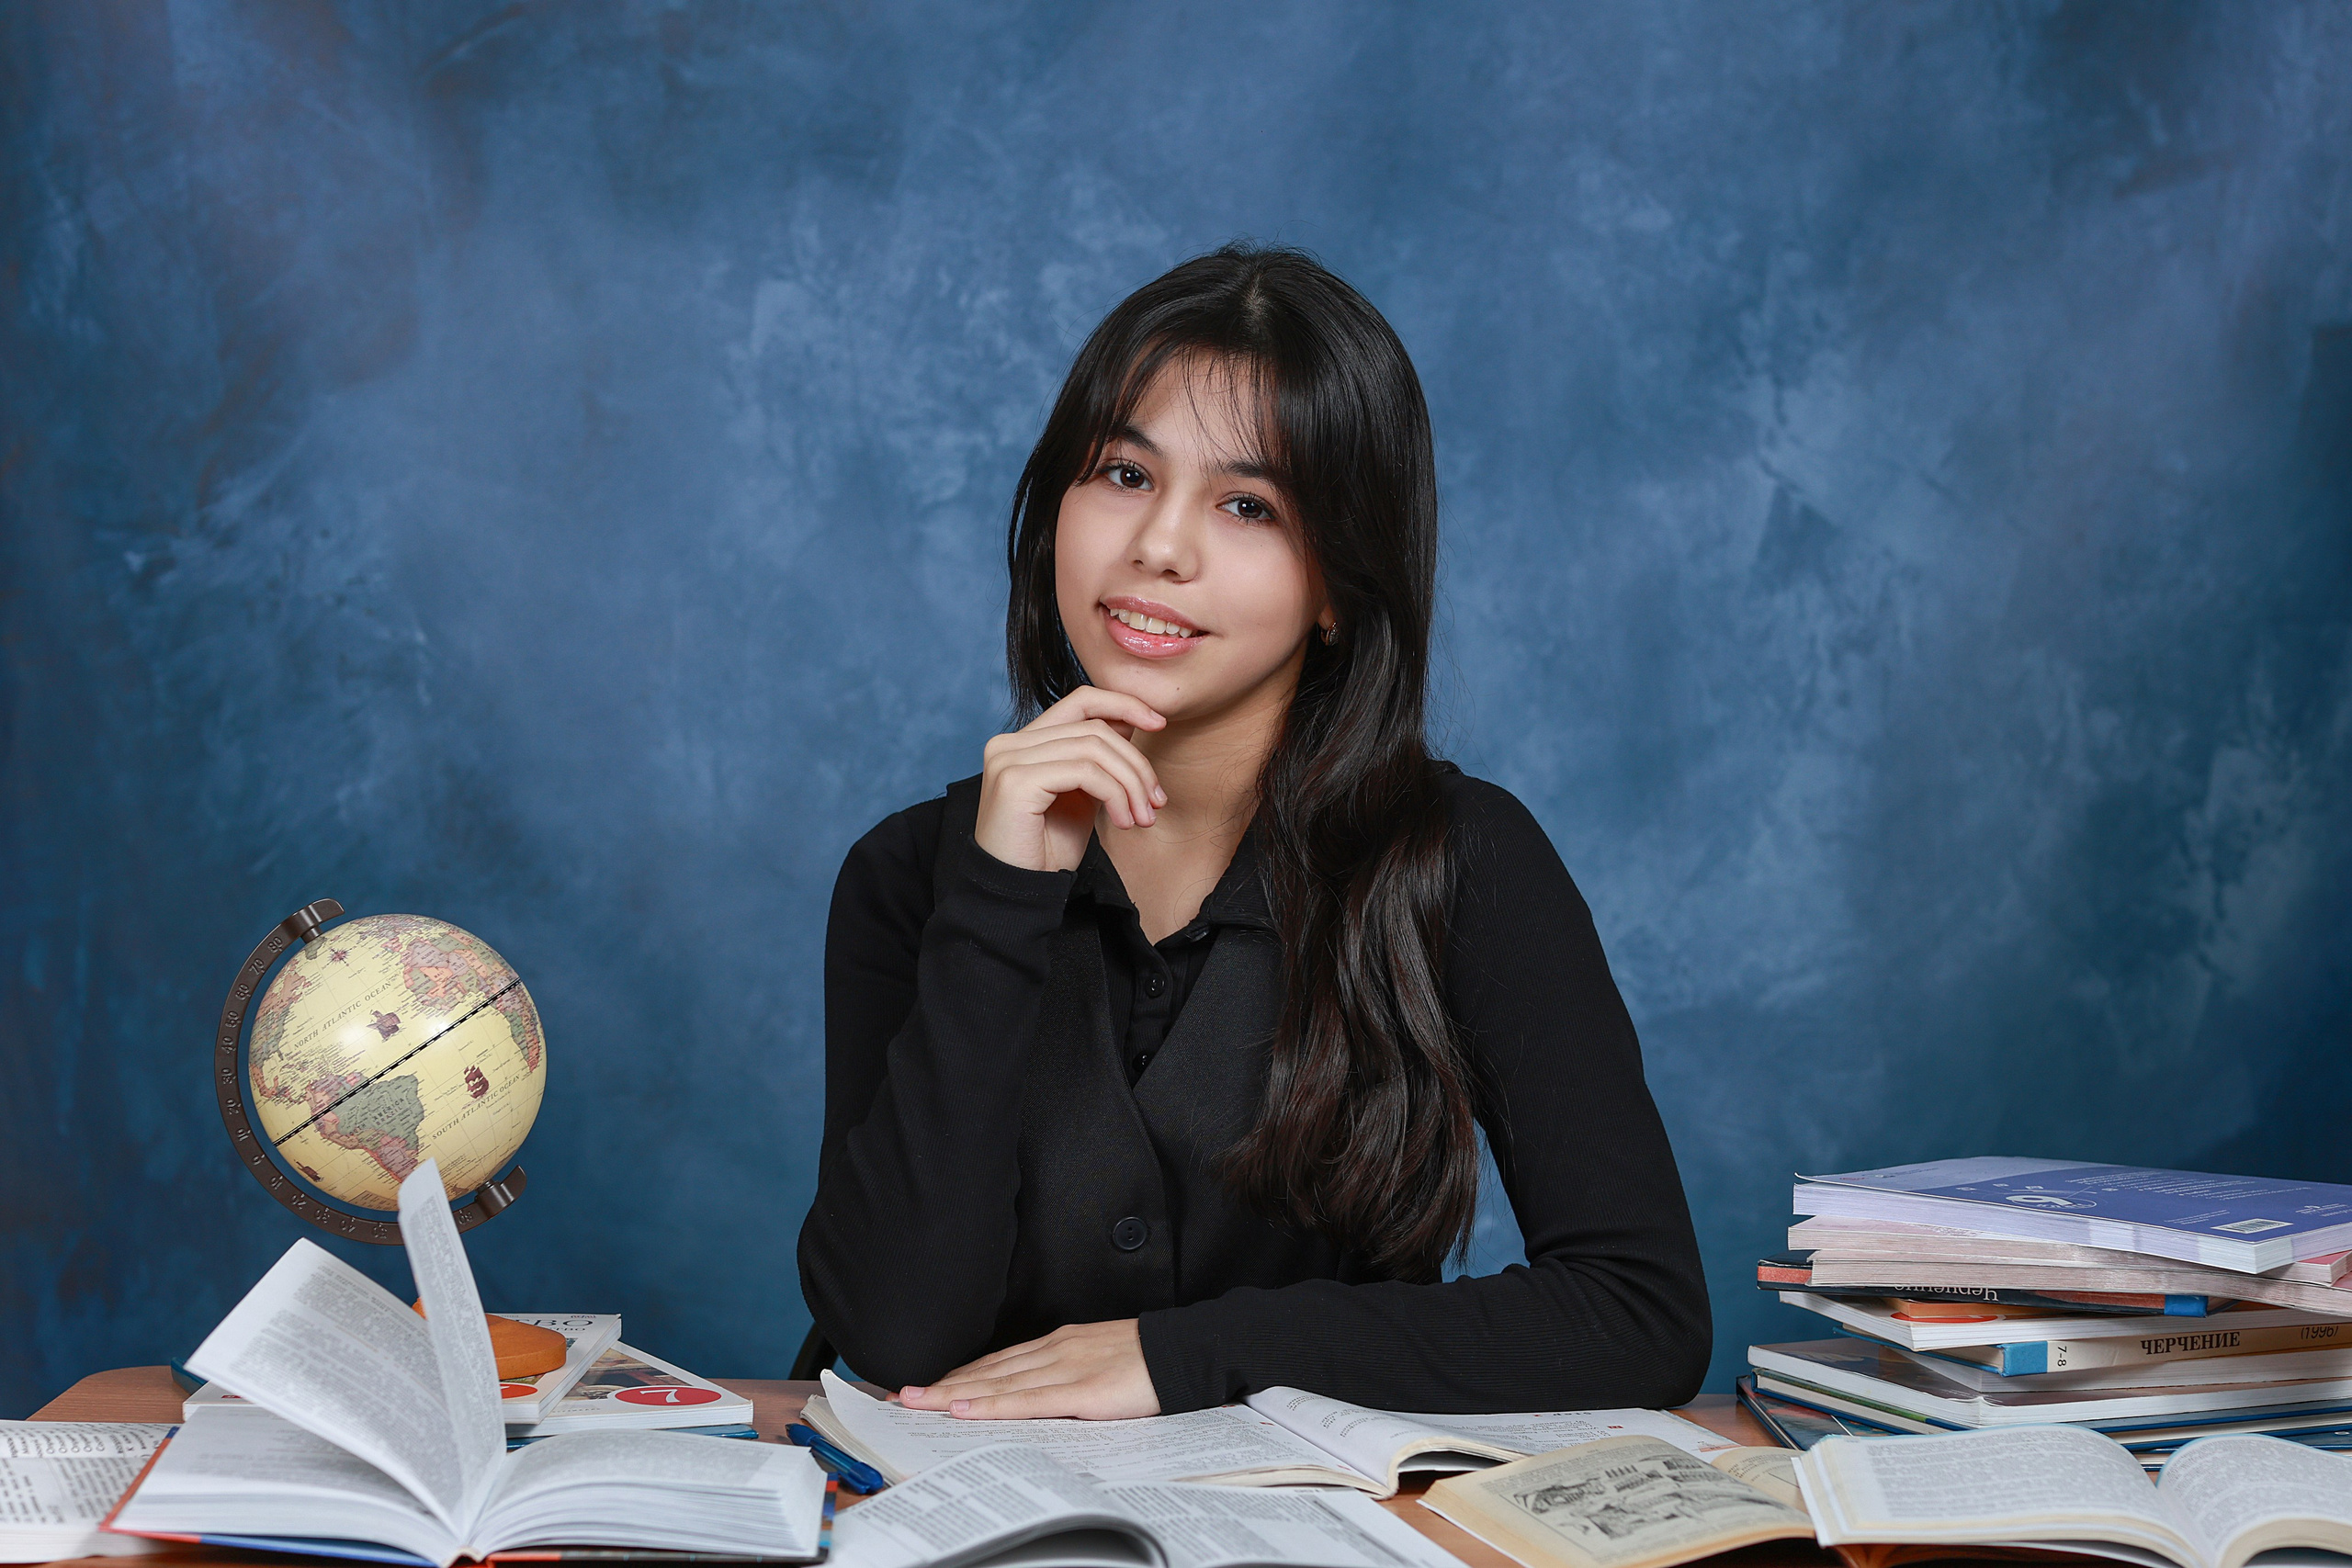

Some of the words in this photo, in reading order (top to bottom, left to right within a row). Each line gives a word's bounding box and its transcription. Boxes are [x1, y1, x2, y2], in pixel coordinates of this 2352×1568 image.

[267, 936, 284, 953] 80
[249, 958, 265, 975] 70
[293, 1029, 321, 1050] NORTH
[322, 1000, 362, 1031] ATLANTIC
[364, 980, 392, 1002] OCEAN
[221, 1035, 234, 1054] 40
[227, 1099, 240, 1115] 20
[370, 1097, 404, 1122] AMERICA
[375, 1104, 403, 1126] BRAZIL
[432, 1117, 460, 1140] SOUTH
[459, 1091, 499, 1122] ATLANTIC
[499, 1074, 522, 1093] OCEAN
[2301, 1325, 2339, 1340] (1996)
[2140, 1332, 2241, 1355] ЧЕРЧЕНИЕ
[2057, 1346, 2067, 1367] 7-8
[639, 1389, 680, 1403] 7
